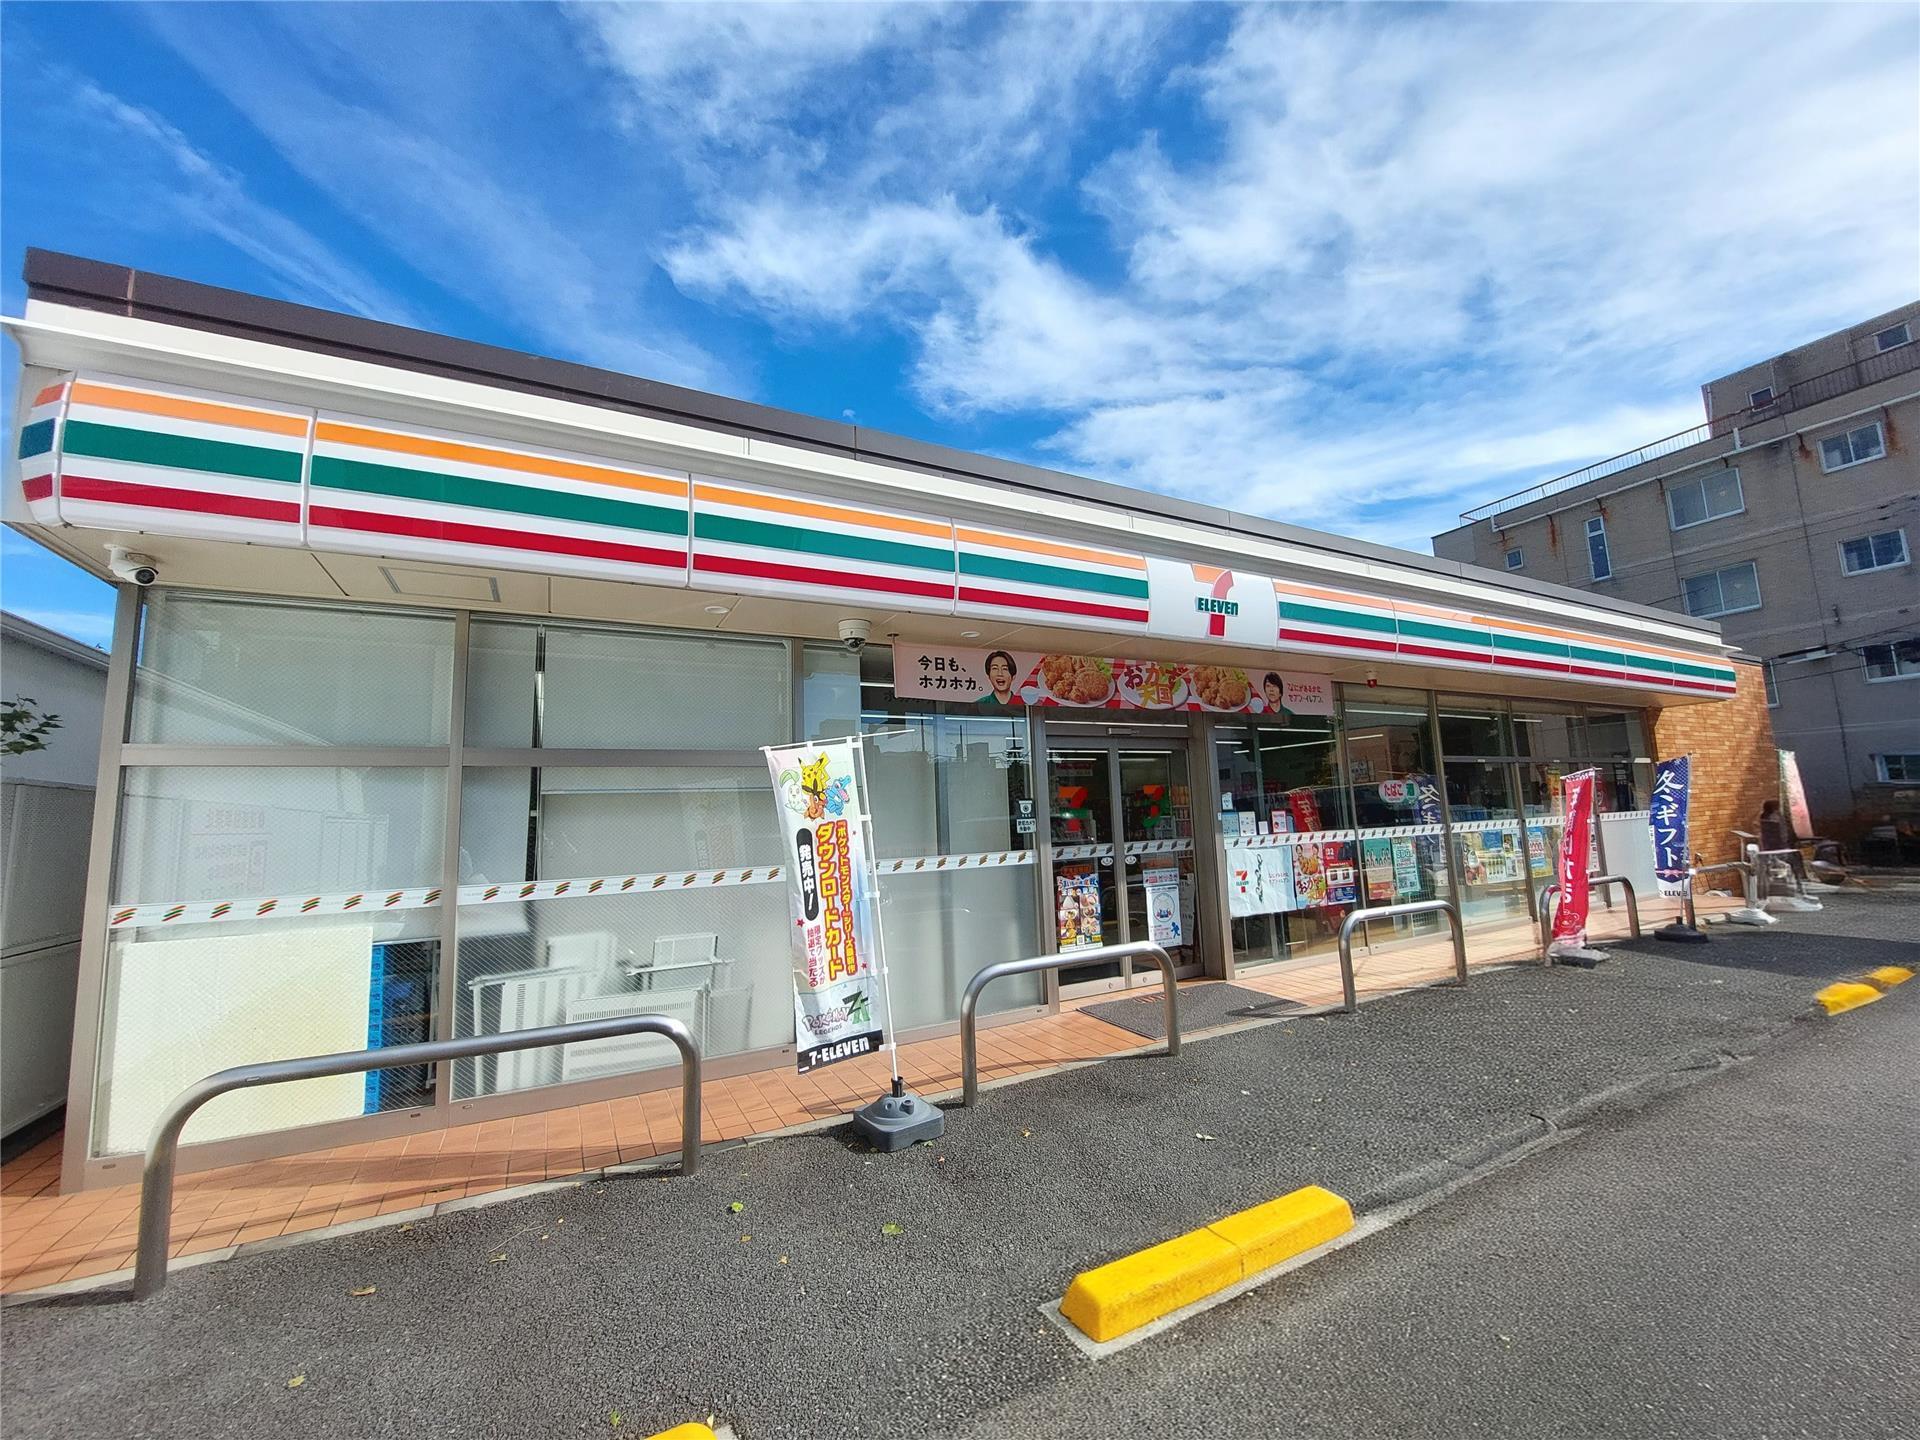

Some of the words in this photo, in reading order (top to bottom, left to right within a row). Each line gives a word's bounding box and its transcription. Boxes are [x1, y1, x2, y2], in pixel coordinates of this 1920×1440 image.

[918, 655, 967, 672] 今日も、
[919, 675, 984, 691] ホカホカ。
[1384, 783, 1404, 797] たばこ
[1653, 769, 1684, 868] 冬ギフト
[816, 821, 845, 981] ダウンロードカード
